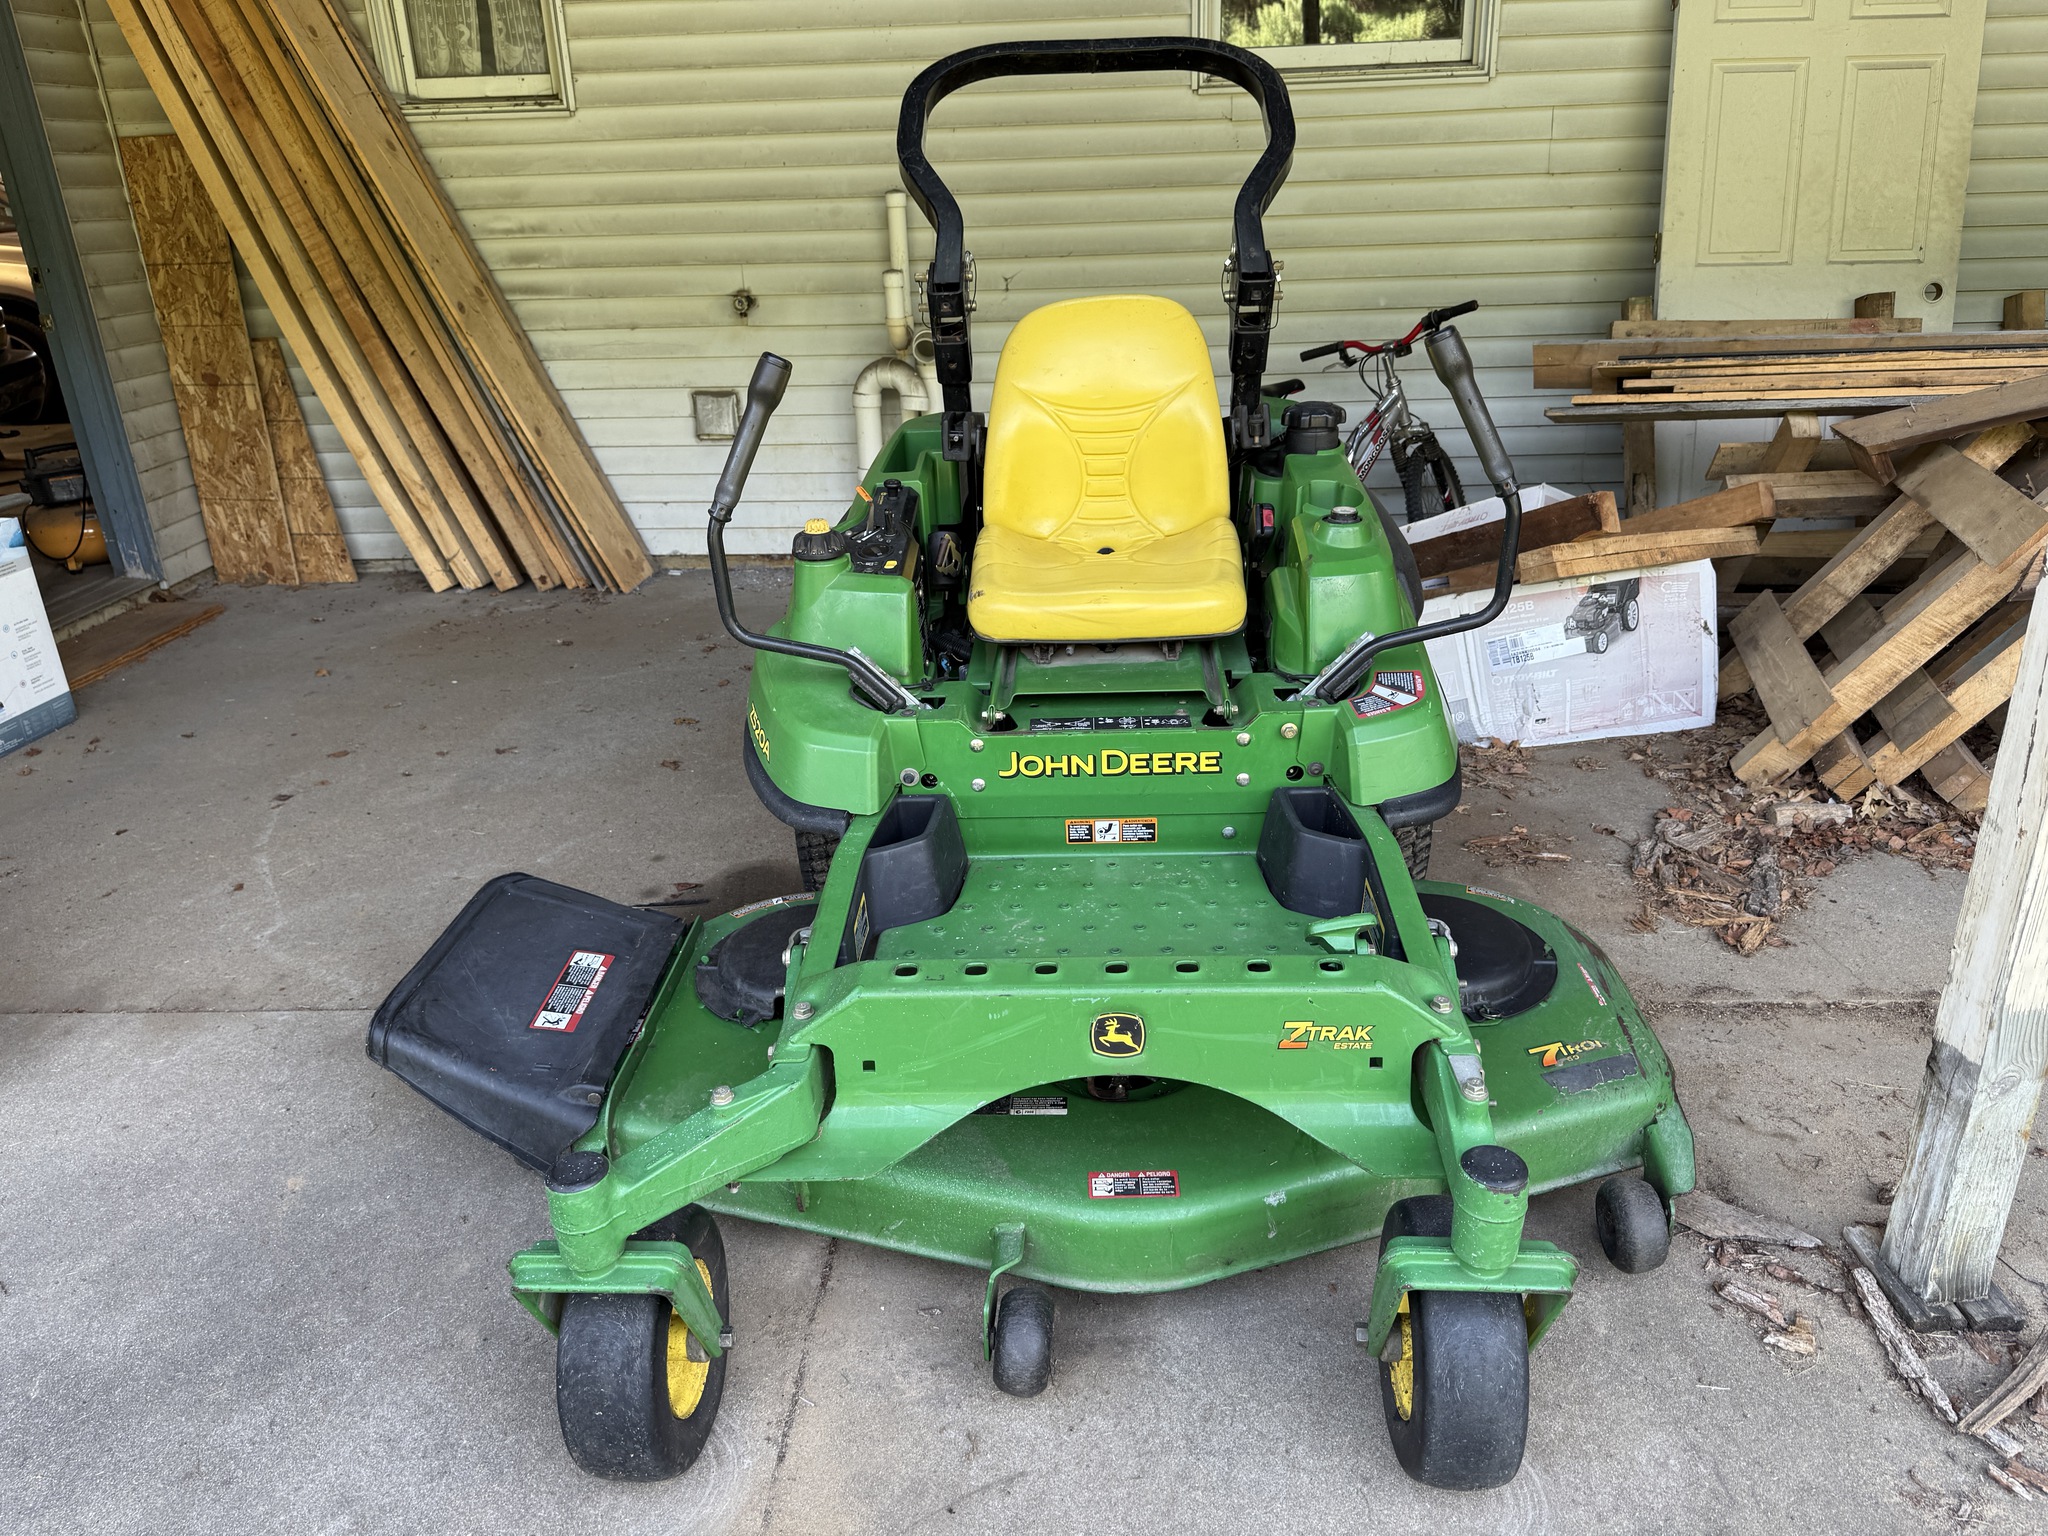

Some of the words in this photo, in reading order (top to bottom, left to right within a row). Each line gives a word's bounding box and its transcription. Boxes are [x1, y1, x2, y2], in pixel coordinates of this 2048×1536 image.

[1359, 423, 1392, 480] MONGOOSE
[1511, 652, 1535, 665] TB125B
[998, 750, 1096, 779] JOHN
[1101, 748, 1222, 776] DEERE
